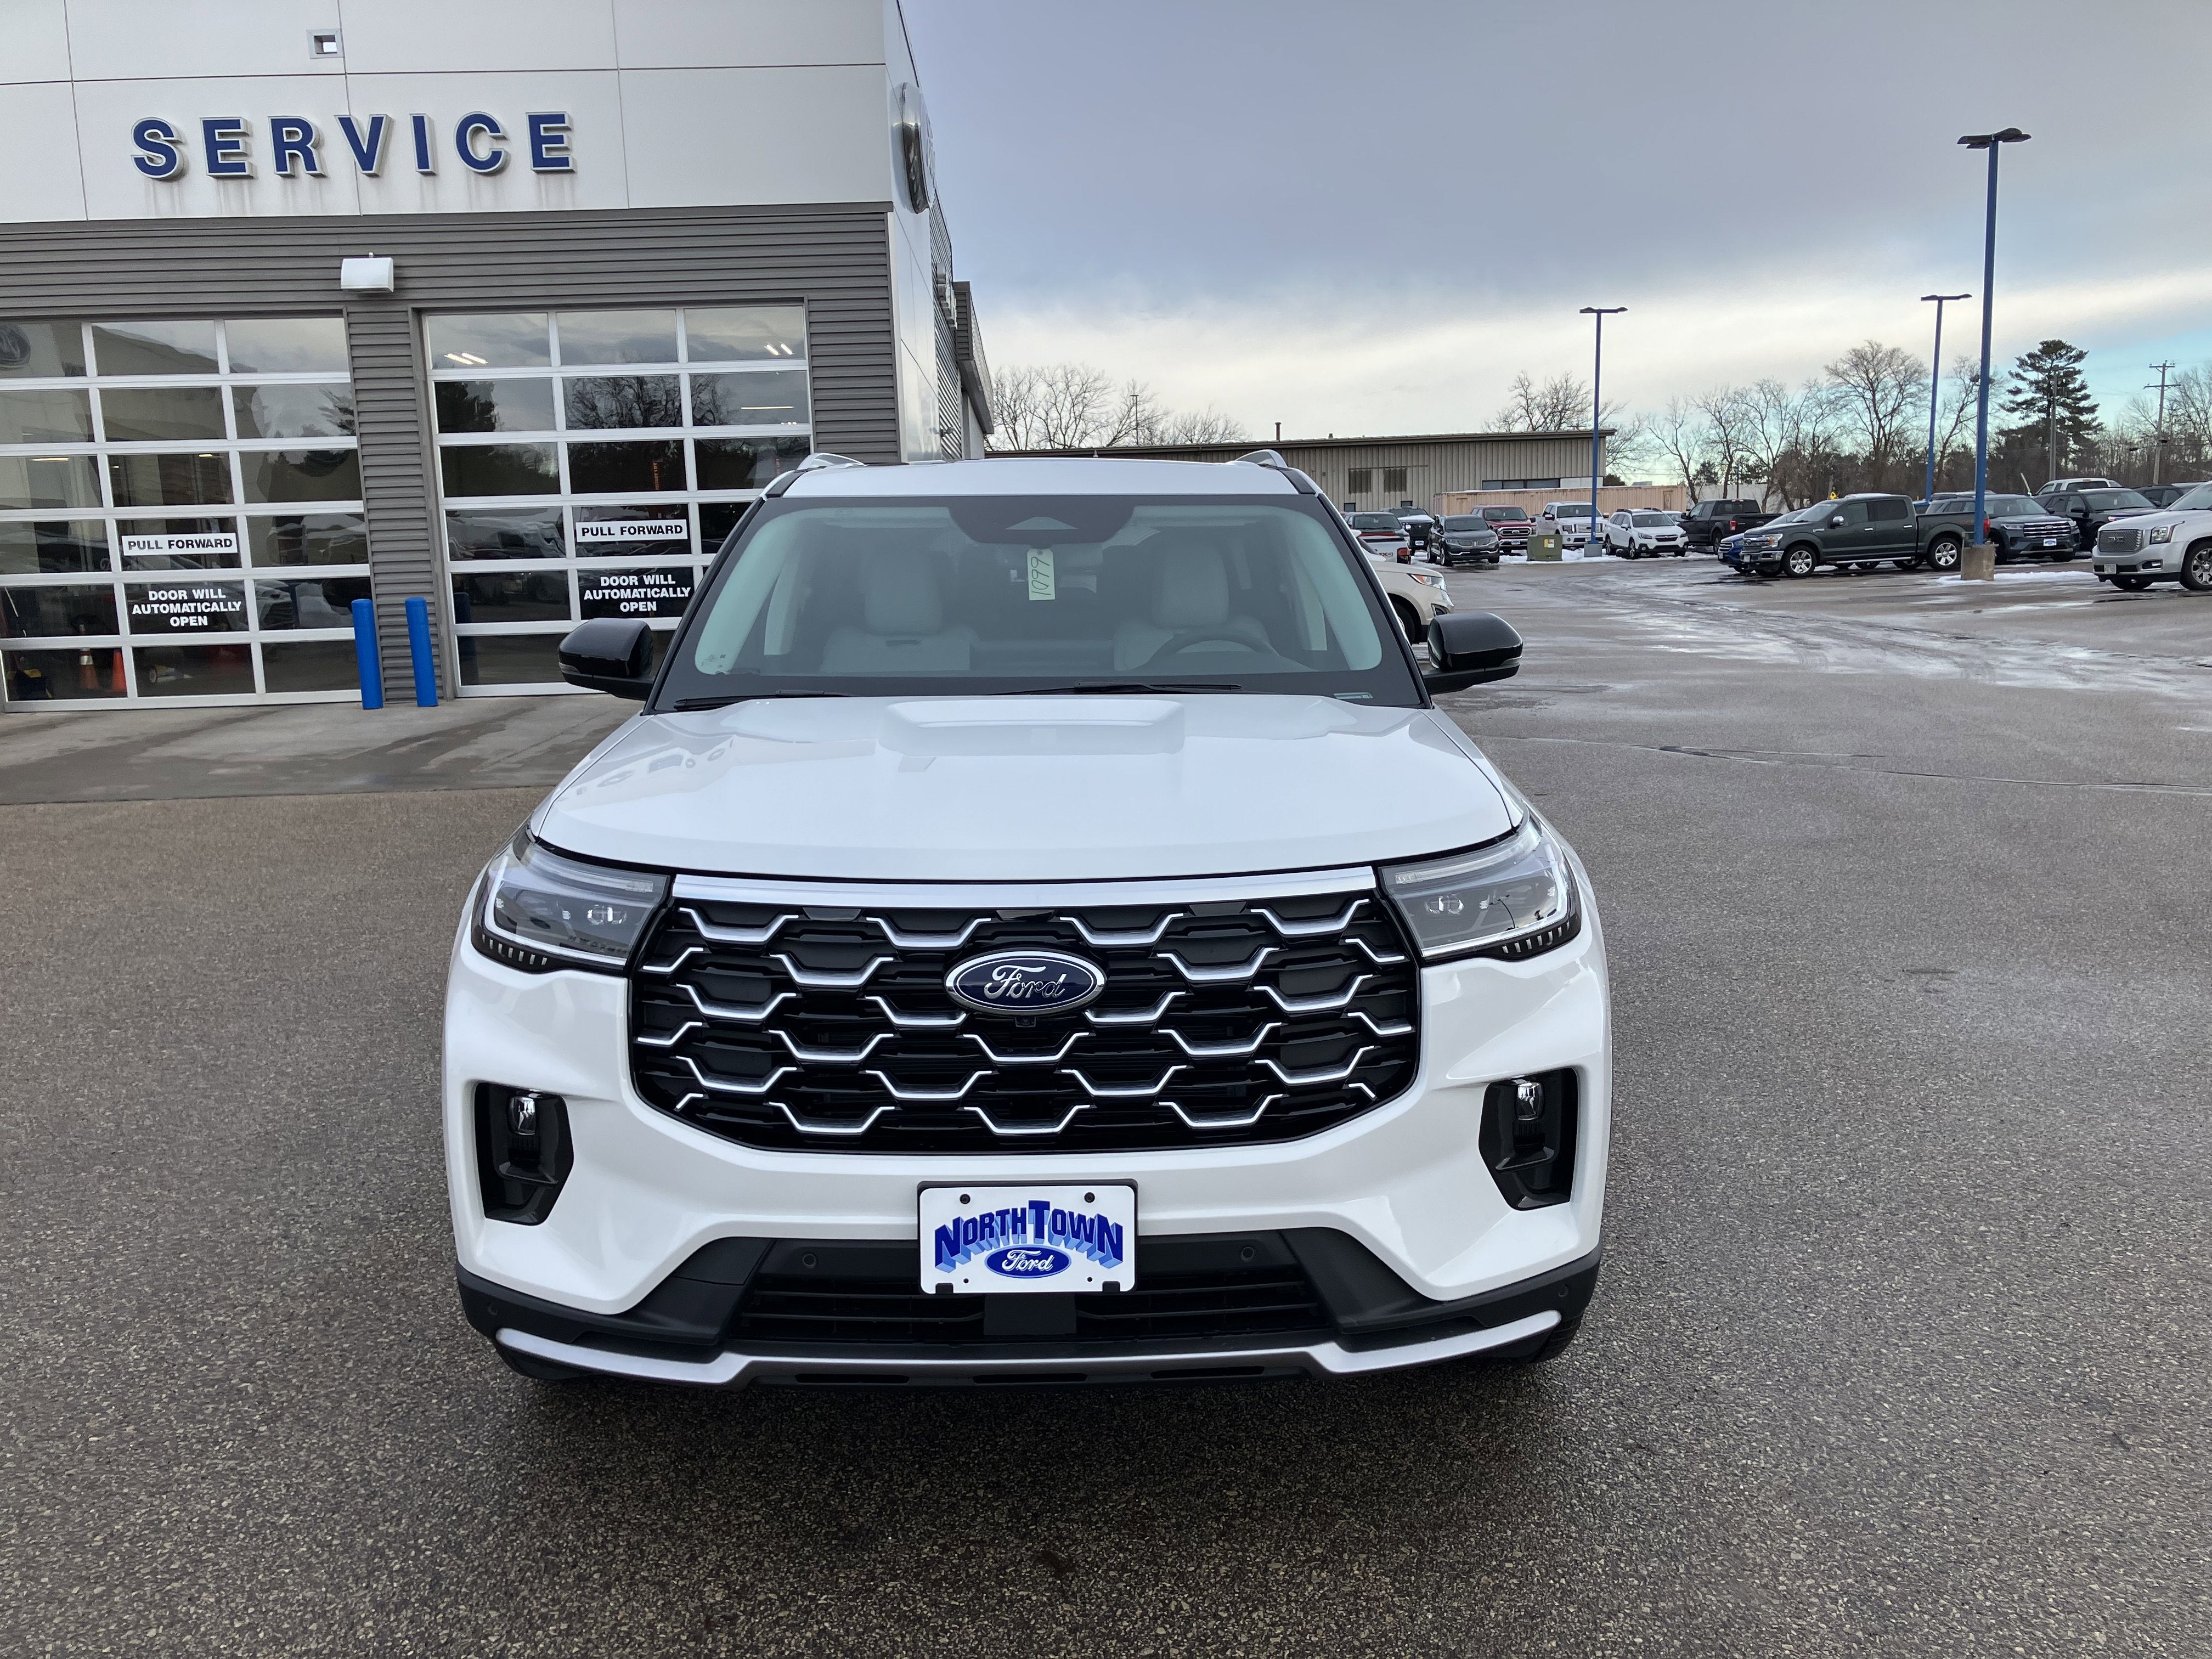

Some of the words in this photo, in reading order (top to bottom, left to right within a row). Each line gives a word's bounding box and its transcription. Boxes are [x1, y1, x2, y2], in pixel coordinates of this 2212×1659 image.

[130, 111, 576, 180] SERVICE
[582, 527, 615, 537] PULL
[620, 524, 683, 535] FORWARD
[128, 539, 163, 550] PULL
[168, 538, 233, 549] FORWARD
[600, 575, 639, 586] DOOR
[643, 574, 676, 585] WILL
[1031, 556, 1051, 595] 1099
[149, 590, 188, 601] DOOR
[192, 588, 226, 600] WILL
[584, 587, 691, 600] AUTOMATICALLY
[132, 601, 242, 615] AUTOMATICALLY
[620, 601, 657, 612] OPEN
[170, 616, 208, 627] OPEN
[984, 964, 1067, 999] Ford
[1001, 1249, 1054, 1272] Ford
